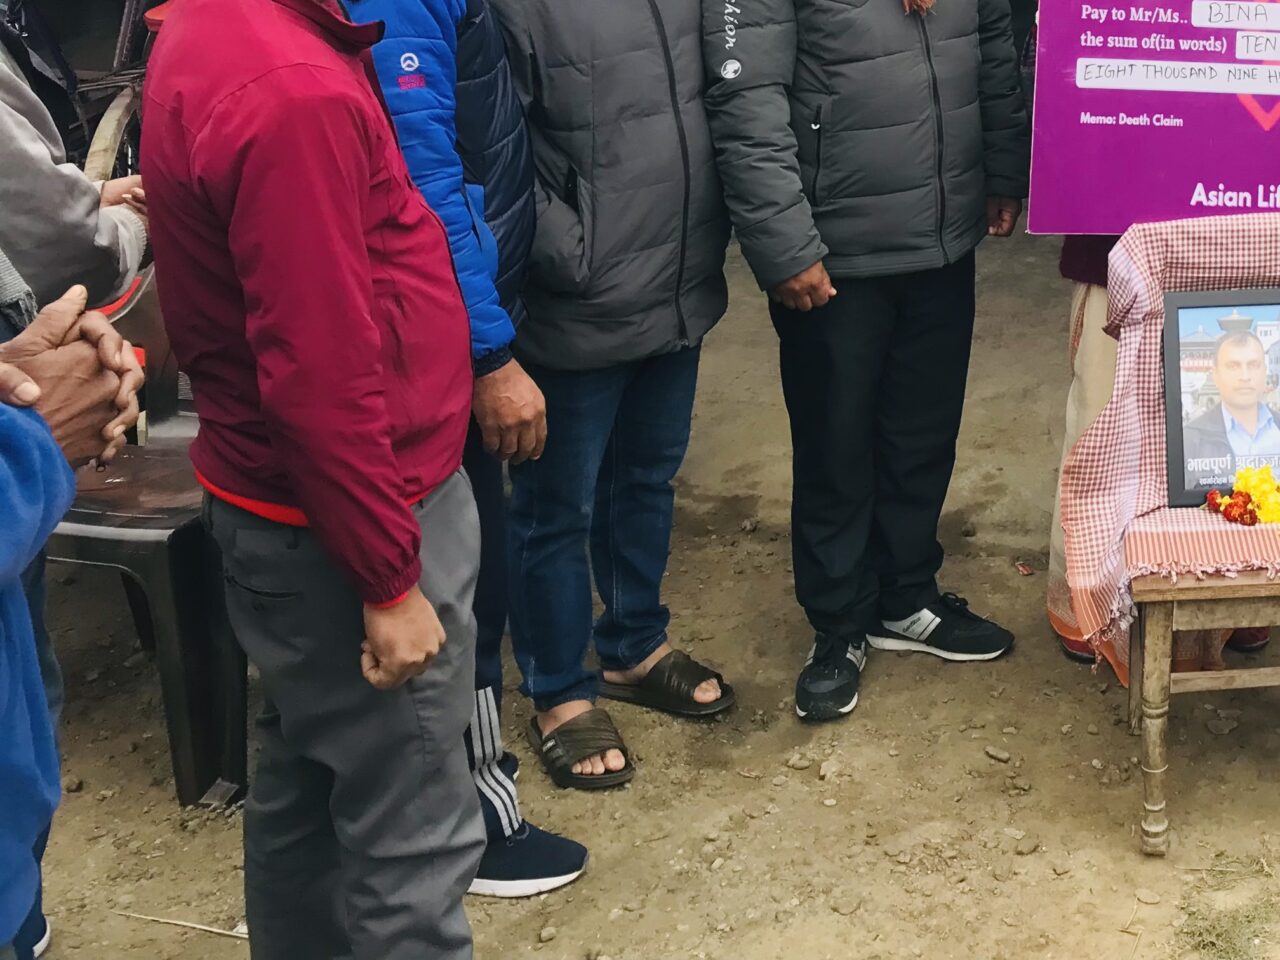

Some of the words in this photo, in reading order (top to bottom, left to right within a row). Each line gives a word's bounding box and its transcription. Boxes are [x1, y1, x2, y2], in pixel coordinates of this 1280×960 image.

[1081, 4, 1108, 22] Pay
[1111, 8, 1126, 21] to
[1208, 2, 1269, 24] BINA
[1080, 31, 1104, 47] the
[1107, 36, 1138, 49] sum
[1180, 36, 1228, 54] words)
[1241, 35, 1278, 54] TEN
[1083, 63, 1135, 81] EIGHT
[1142, 64, 1218, 80] THOUSAND
[1227, 67, 1259, 81] NINE
[1080, 112, 1116, 125] Memo:
[1118, 112, 1150, 126] Death
[1152, 113, 1184, 127] Claim
[1190, 182, 1252, 208] Asian
